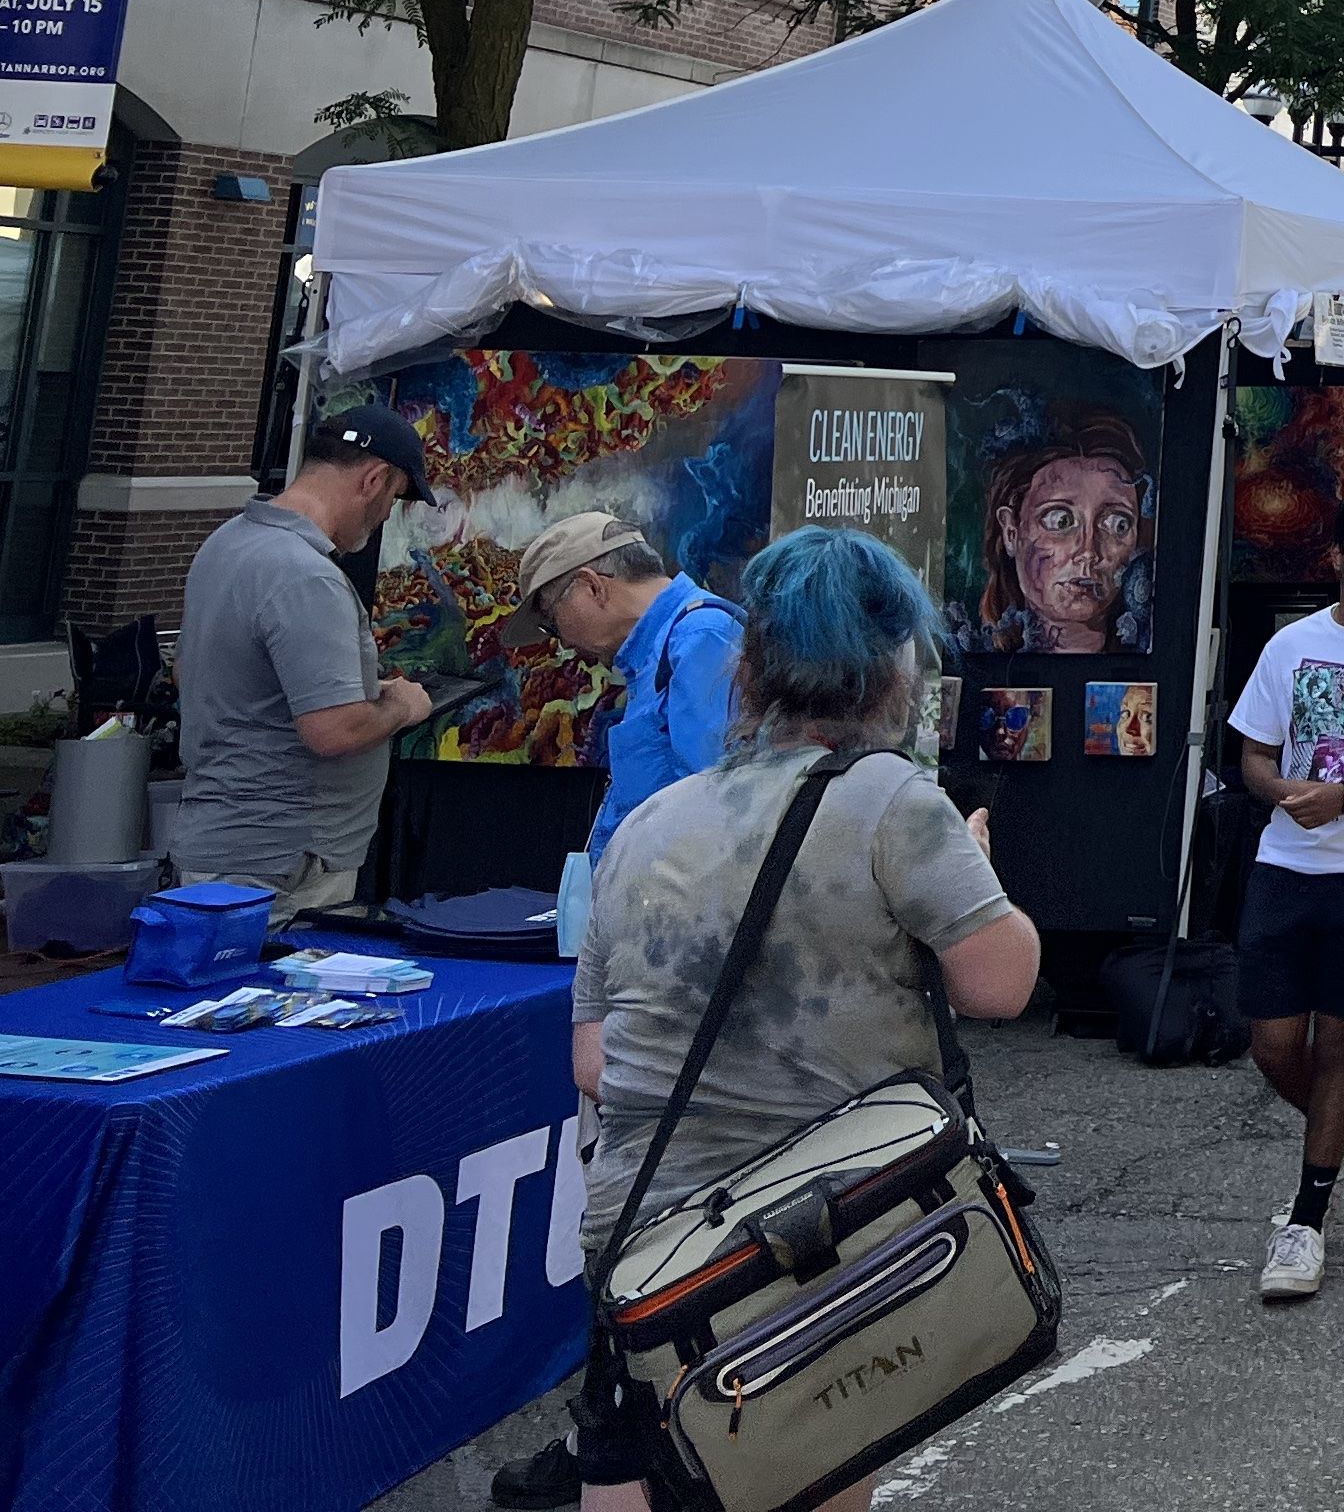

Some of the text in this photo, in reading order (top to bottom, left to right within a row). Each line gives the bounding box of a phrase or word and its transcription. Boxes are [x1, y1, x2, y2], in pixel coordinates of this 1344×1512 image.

[12, 20, 32, 34] 10
[35, 20, 64, 35] PM
[809, 409, 924, 463] CLEAN ENERGY
[805, 475, 920, 524] Benefitting Michigan
[812, 1335, 926, 1410] TITAN
